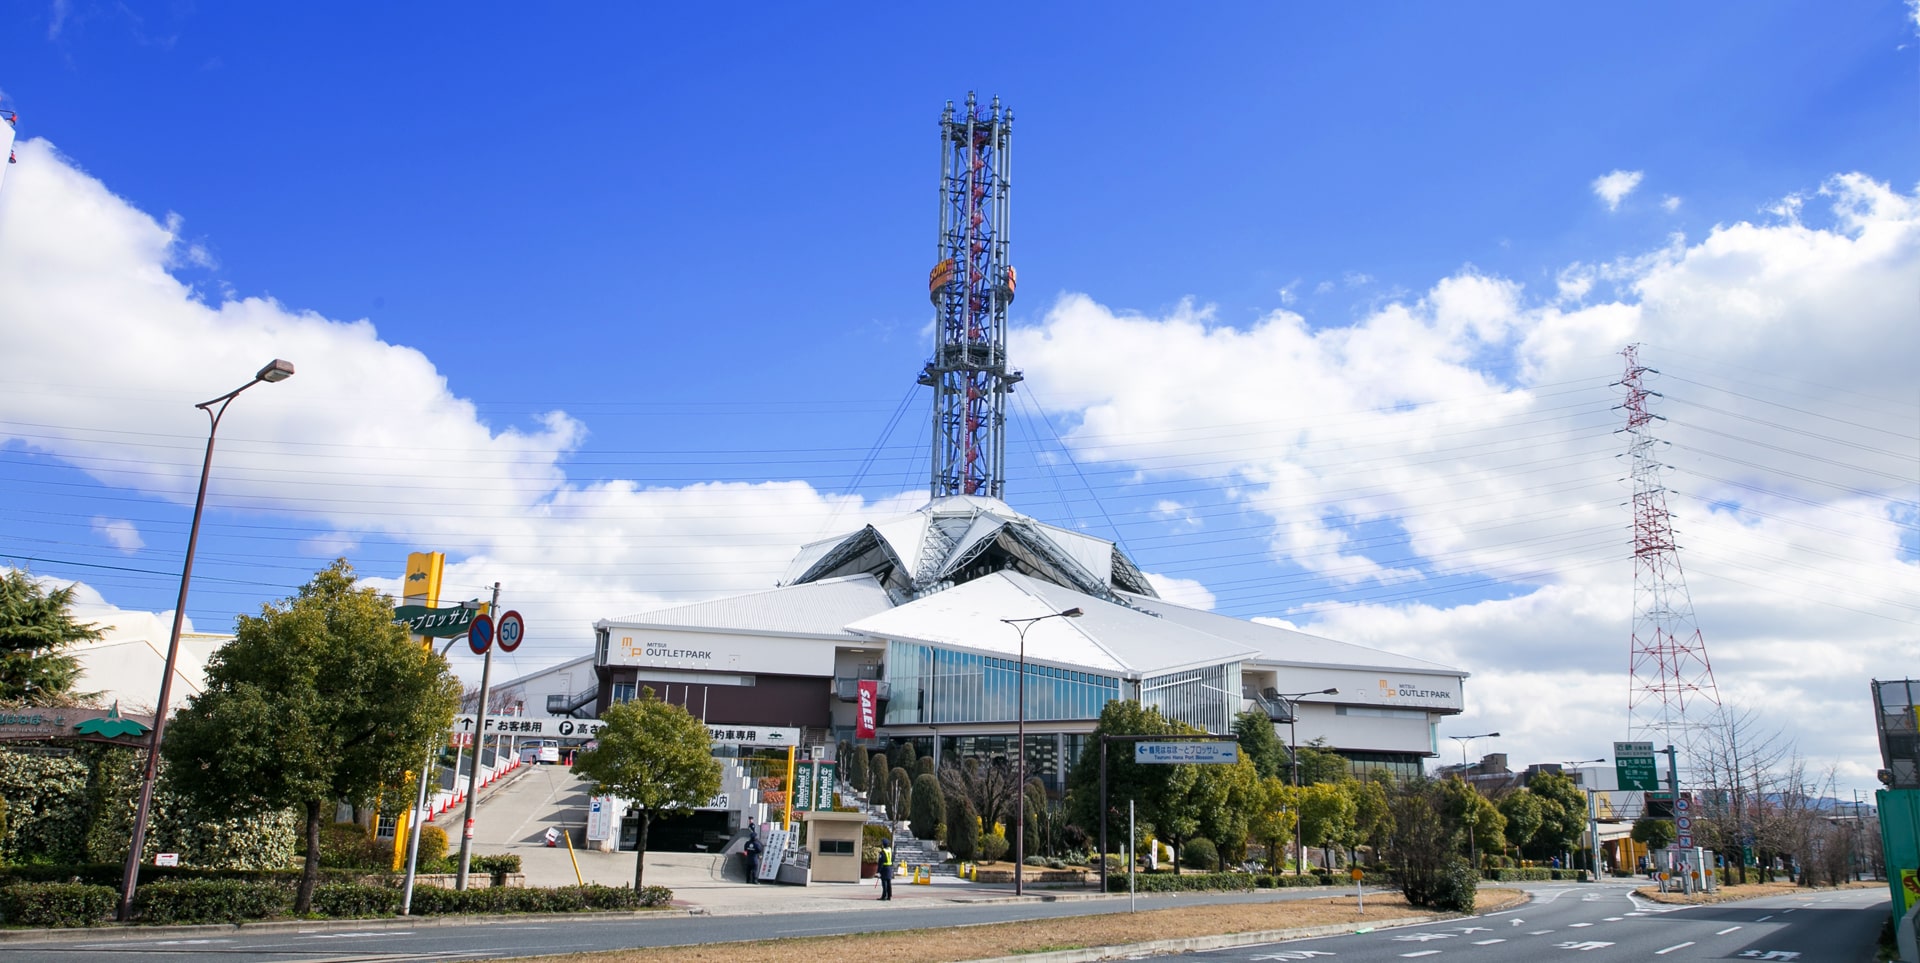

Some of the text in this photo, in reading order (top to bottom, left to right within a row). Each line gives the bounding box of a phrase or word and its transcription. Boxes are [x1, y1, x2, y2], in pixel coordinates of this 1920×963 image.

[502, 622, 518, 640] 50
[860, 688, 874, 730] SALE!
[497, 721, 542, 732] お客様用
[577, 723, 606, 735] 高さ
